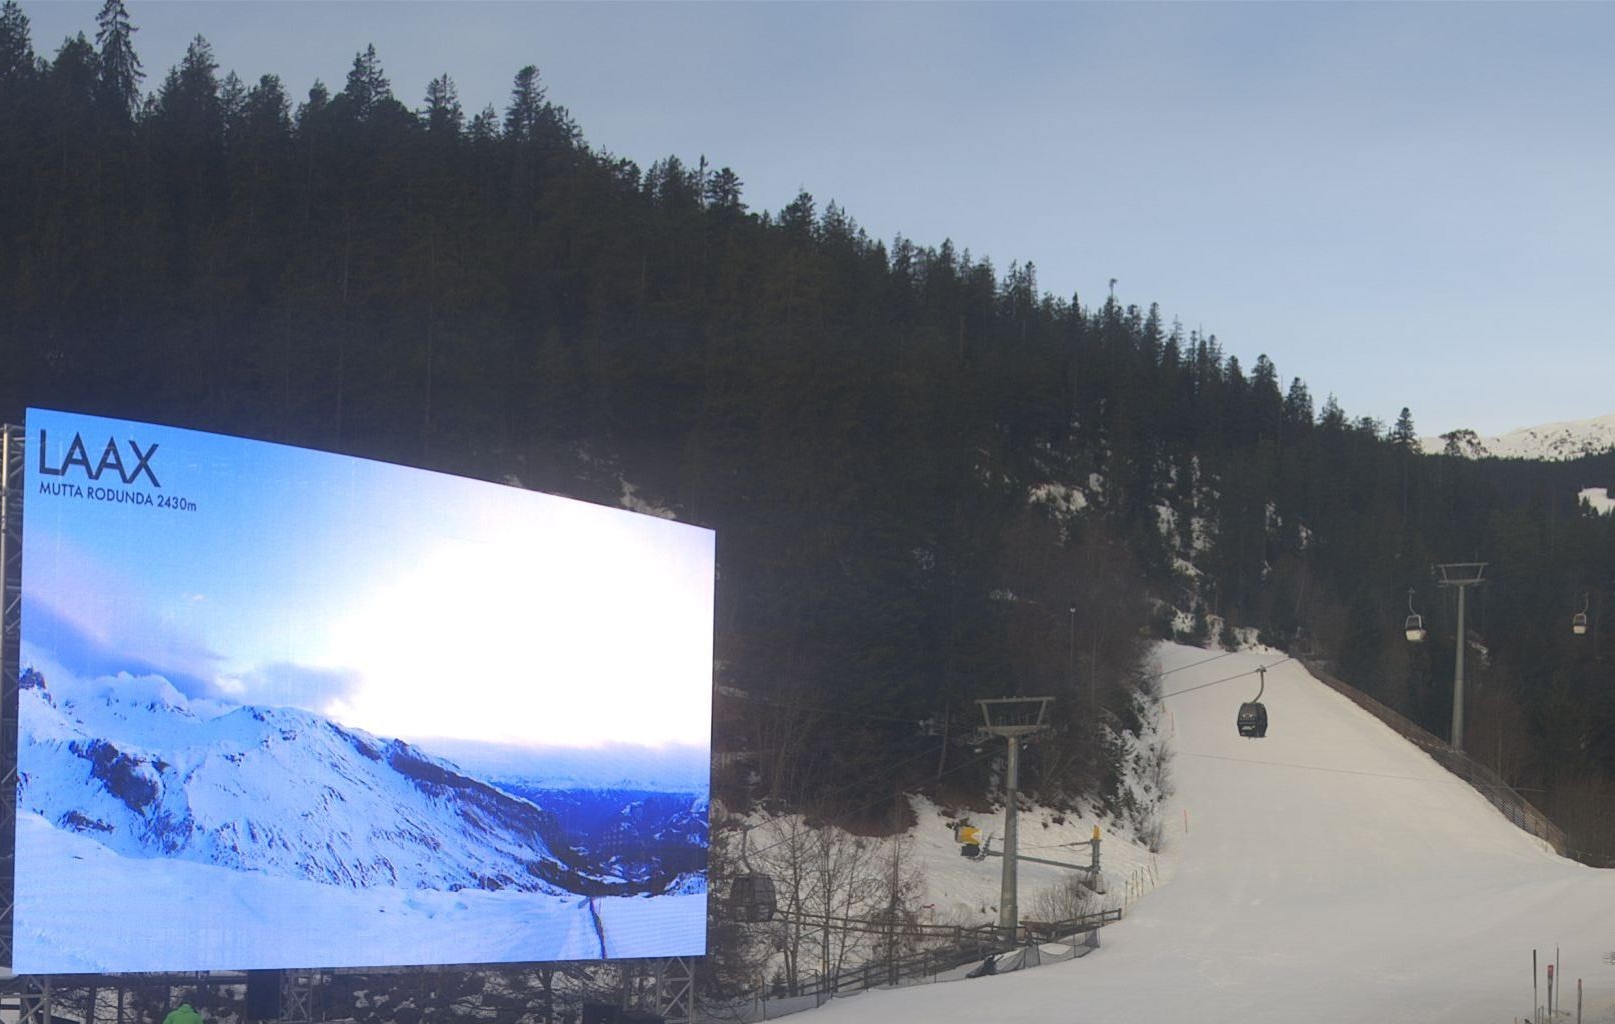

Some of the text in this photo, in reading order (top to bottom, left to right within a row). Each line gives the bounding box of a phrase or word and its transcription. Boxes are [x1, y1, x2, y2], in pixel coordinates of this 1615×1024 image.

[39, 428, 162, 489] LAAX
[39, 481, 197, 512] MUTTA RODUNDA 2430m
